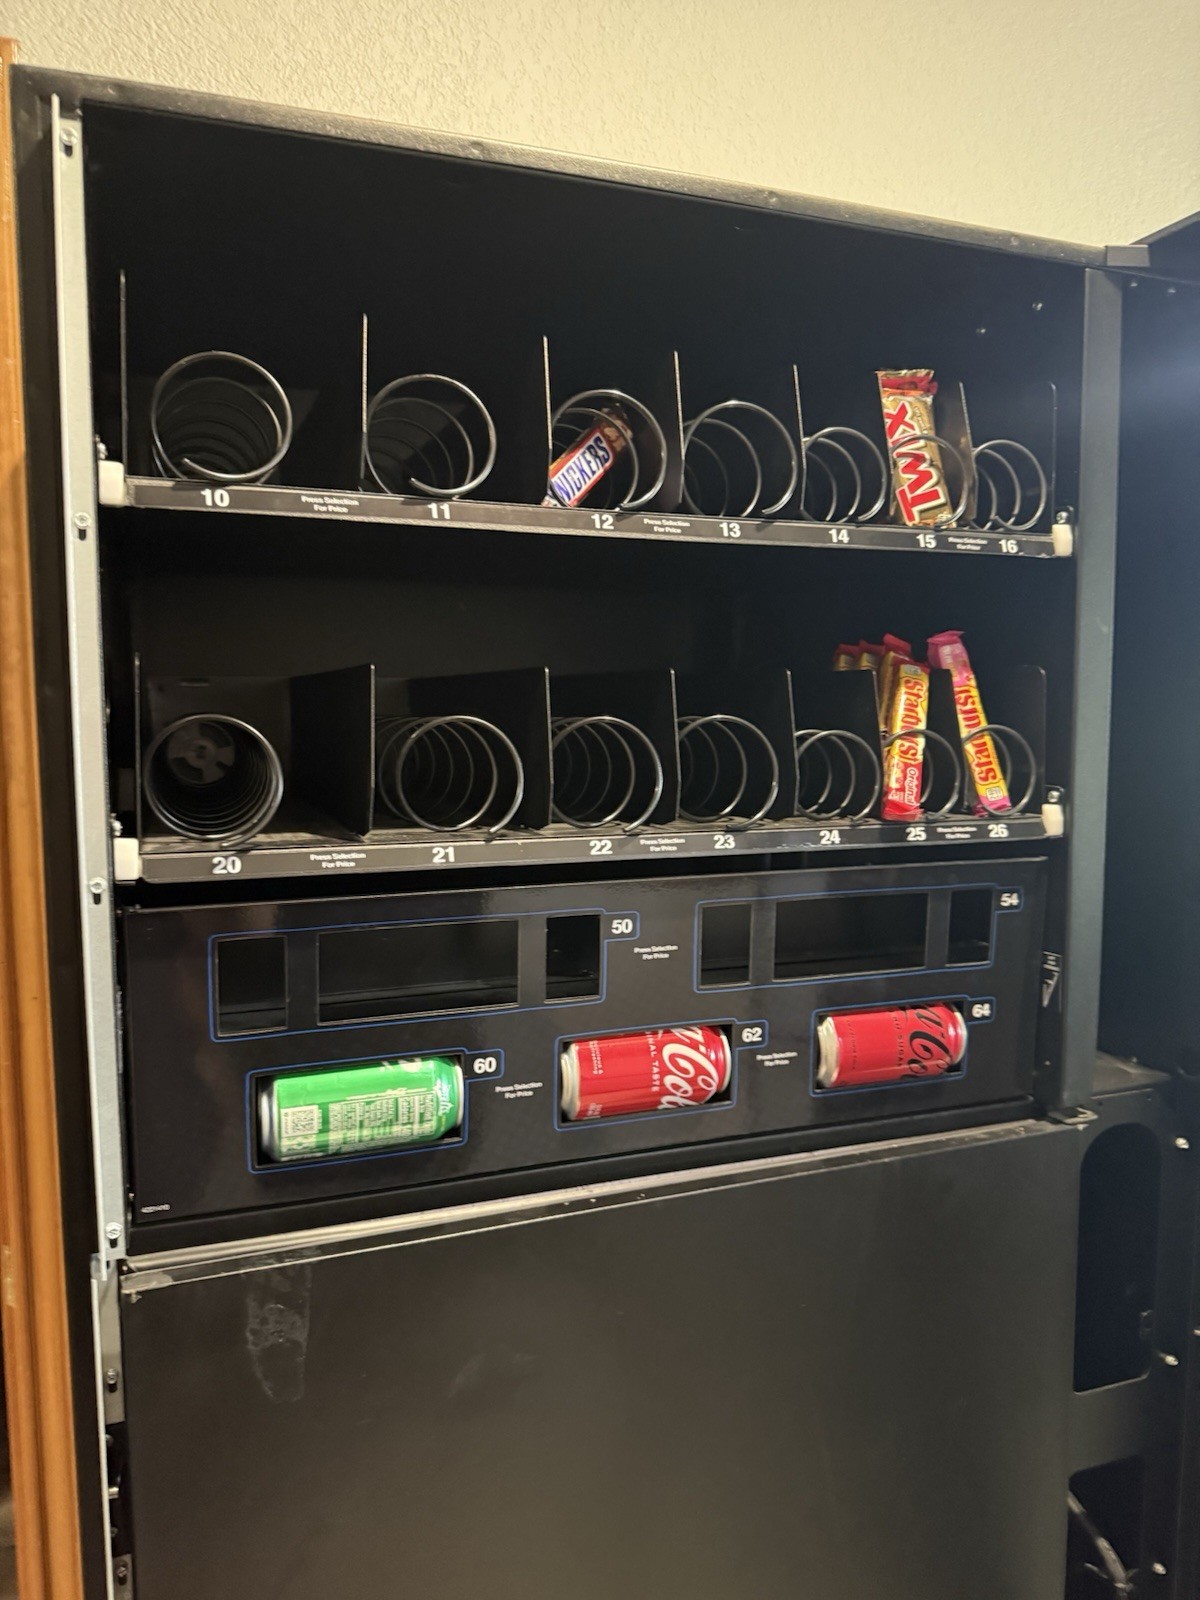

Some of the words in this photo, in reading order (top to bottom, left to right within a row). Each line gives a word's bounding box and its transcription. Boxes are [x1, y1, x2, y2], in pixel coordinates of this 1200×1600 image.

[547, 435, 610, 501] NICKERS
[884, 402, 941, 523] TWIX
[201, 488, 230, 507] 10
[301, 495, 324, 503] Press
[324, 496, 359, 505] Selection
[427, 502, 451, 520] 11
[591, 513, 614, 530] 12
[662, 519, 690, 527] Selection
[719, 522, 741, 538] 13
[828, 529, 850, 544] 14
[916, 533, 937, 549] 15
[998, 539, 1019, 553] 16
[904, 767, 918, 806] Original
[819, 829, 841, 845] 24
[905, 827, 927, 841] 25
[987, 824, 1009, 838] 26
[589, 839, 613, 855] 22
[713, 834, 736, 849] 23
[332, 852, 367, 860] Selection
[431, 846, 455, 863] 21
[212, 856, 242, 874] 20
[1000, 892, 1019, 907] 54
[611, 918, 633, 934] 50
[971, 1003, 991, 1018] 64
[742, 1027, 763, 1043] 62
[473, 1056, 497, 1074] 60
[645, 1032, 657, 1058] INAL
[651, 1060, 661, 1092] TASTE
